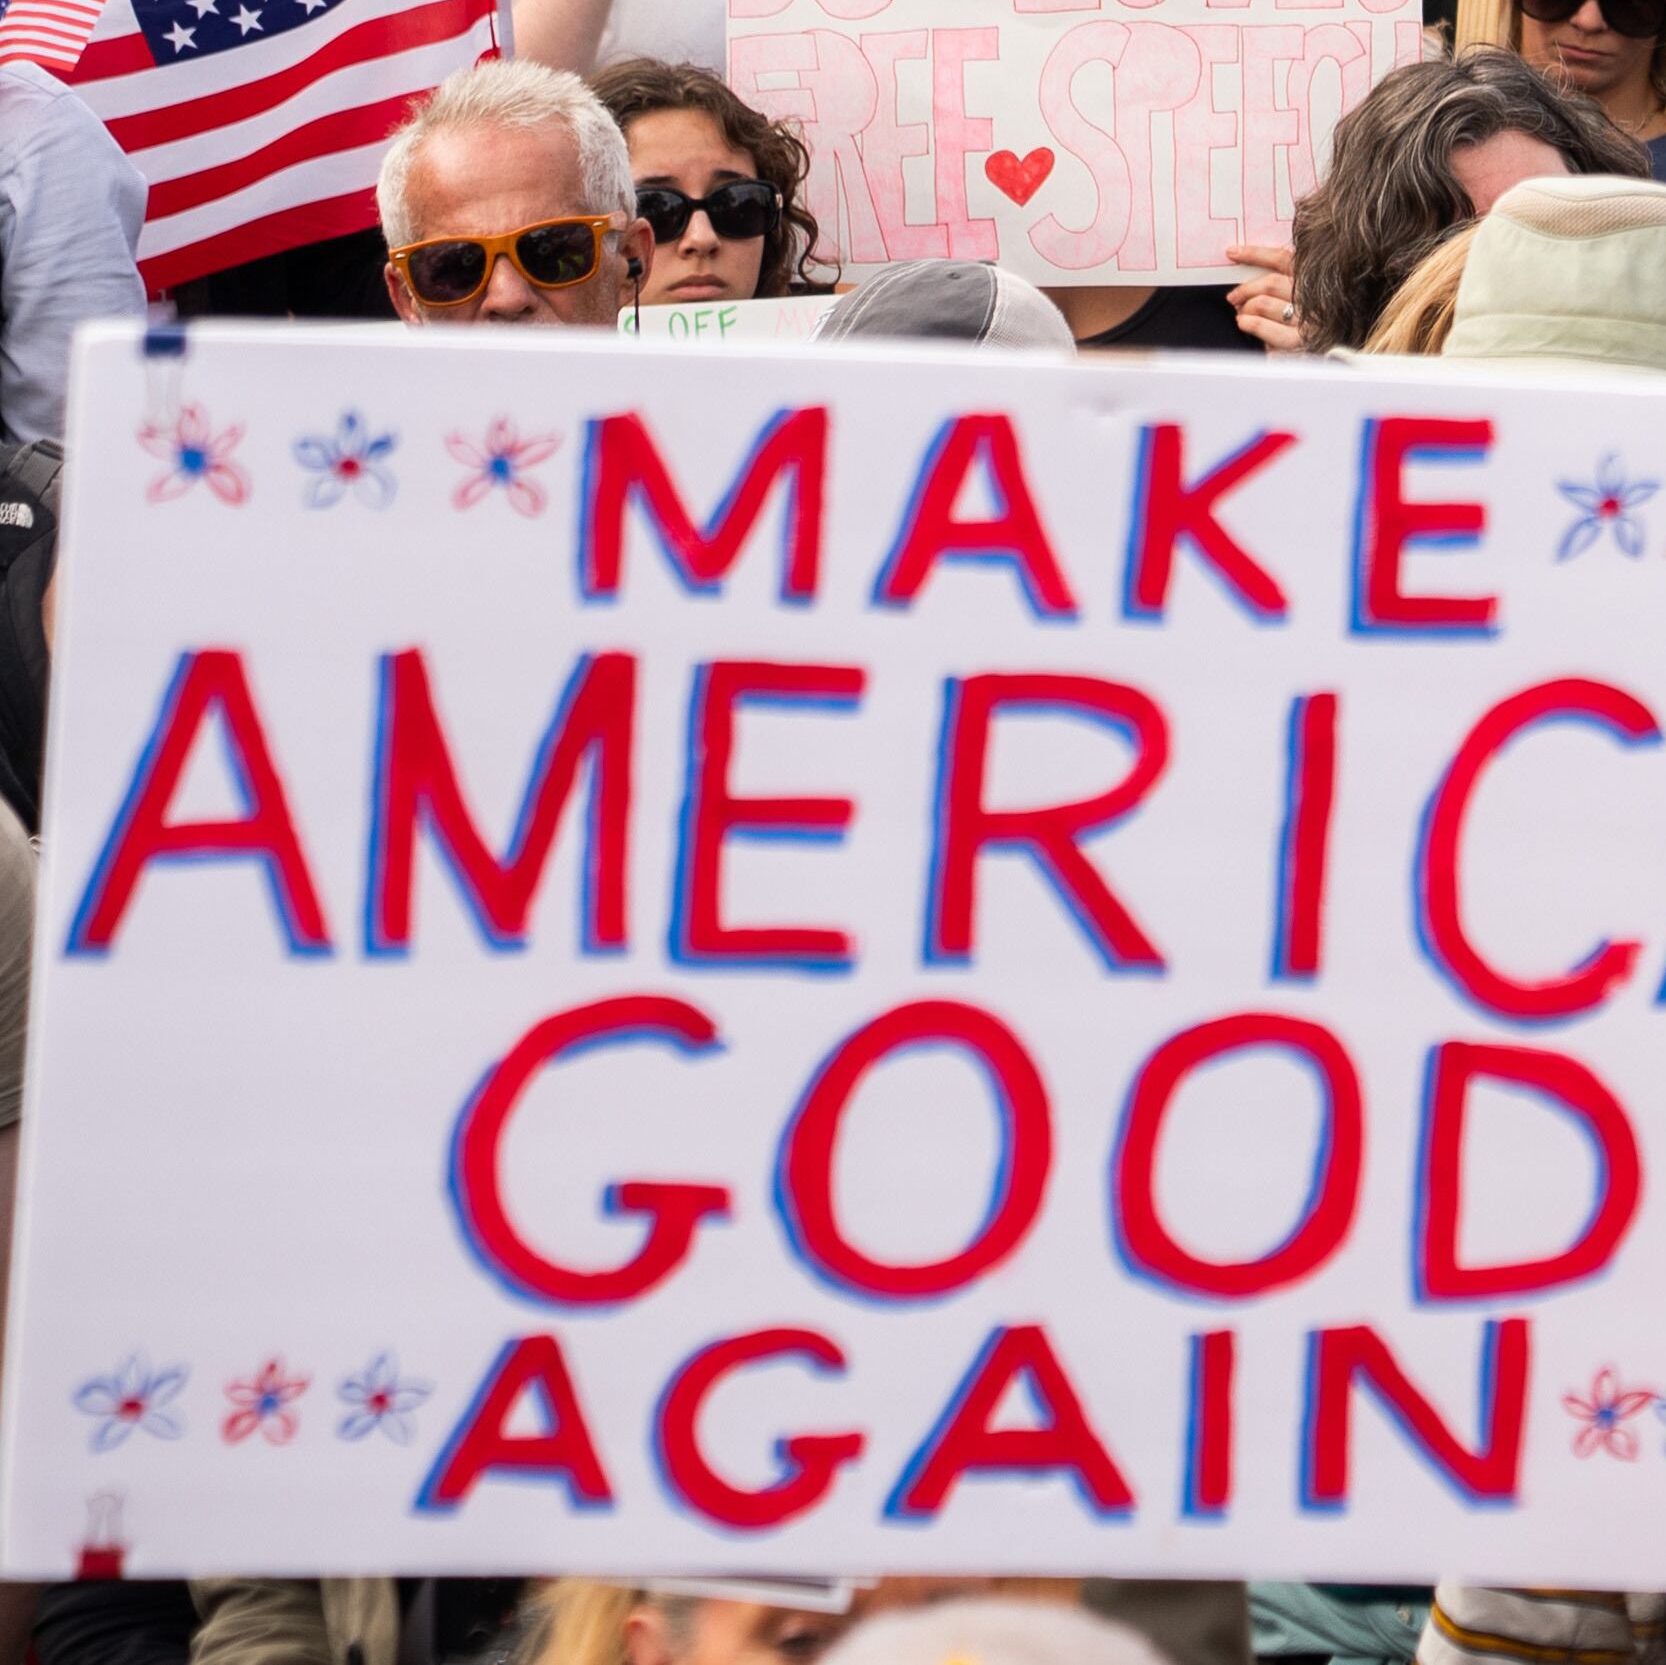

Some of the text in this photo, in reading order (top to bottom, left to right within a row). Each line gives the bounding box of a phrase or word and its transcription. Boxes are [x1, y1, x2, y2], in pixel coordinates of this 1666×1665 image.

[729, 18, 1423, 274] FREE SPEEC
[577, 404, 1504, 643] MAKE
[446, 993, 1644, 1310] GOOD
[409, 1316, 1532, 1538] AGAIN
